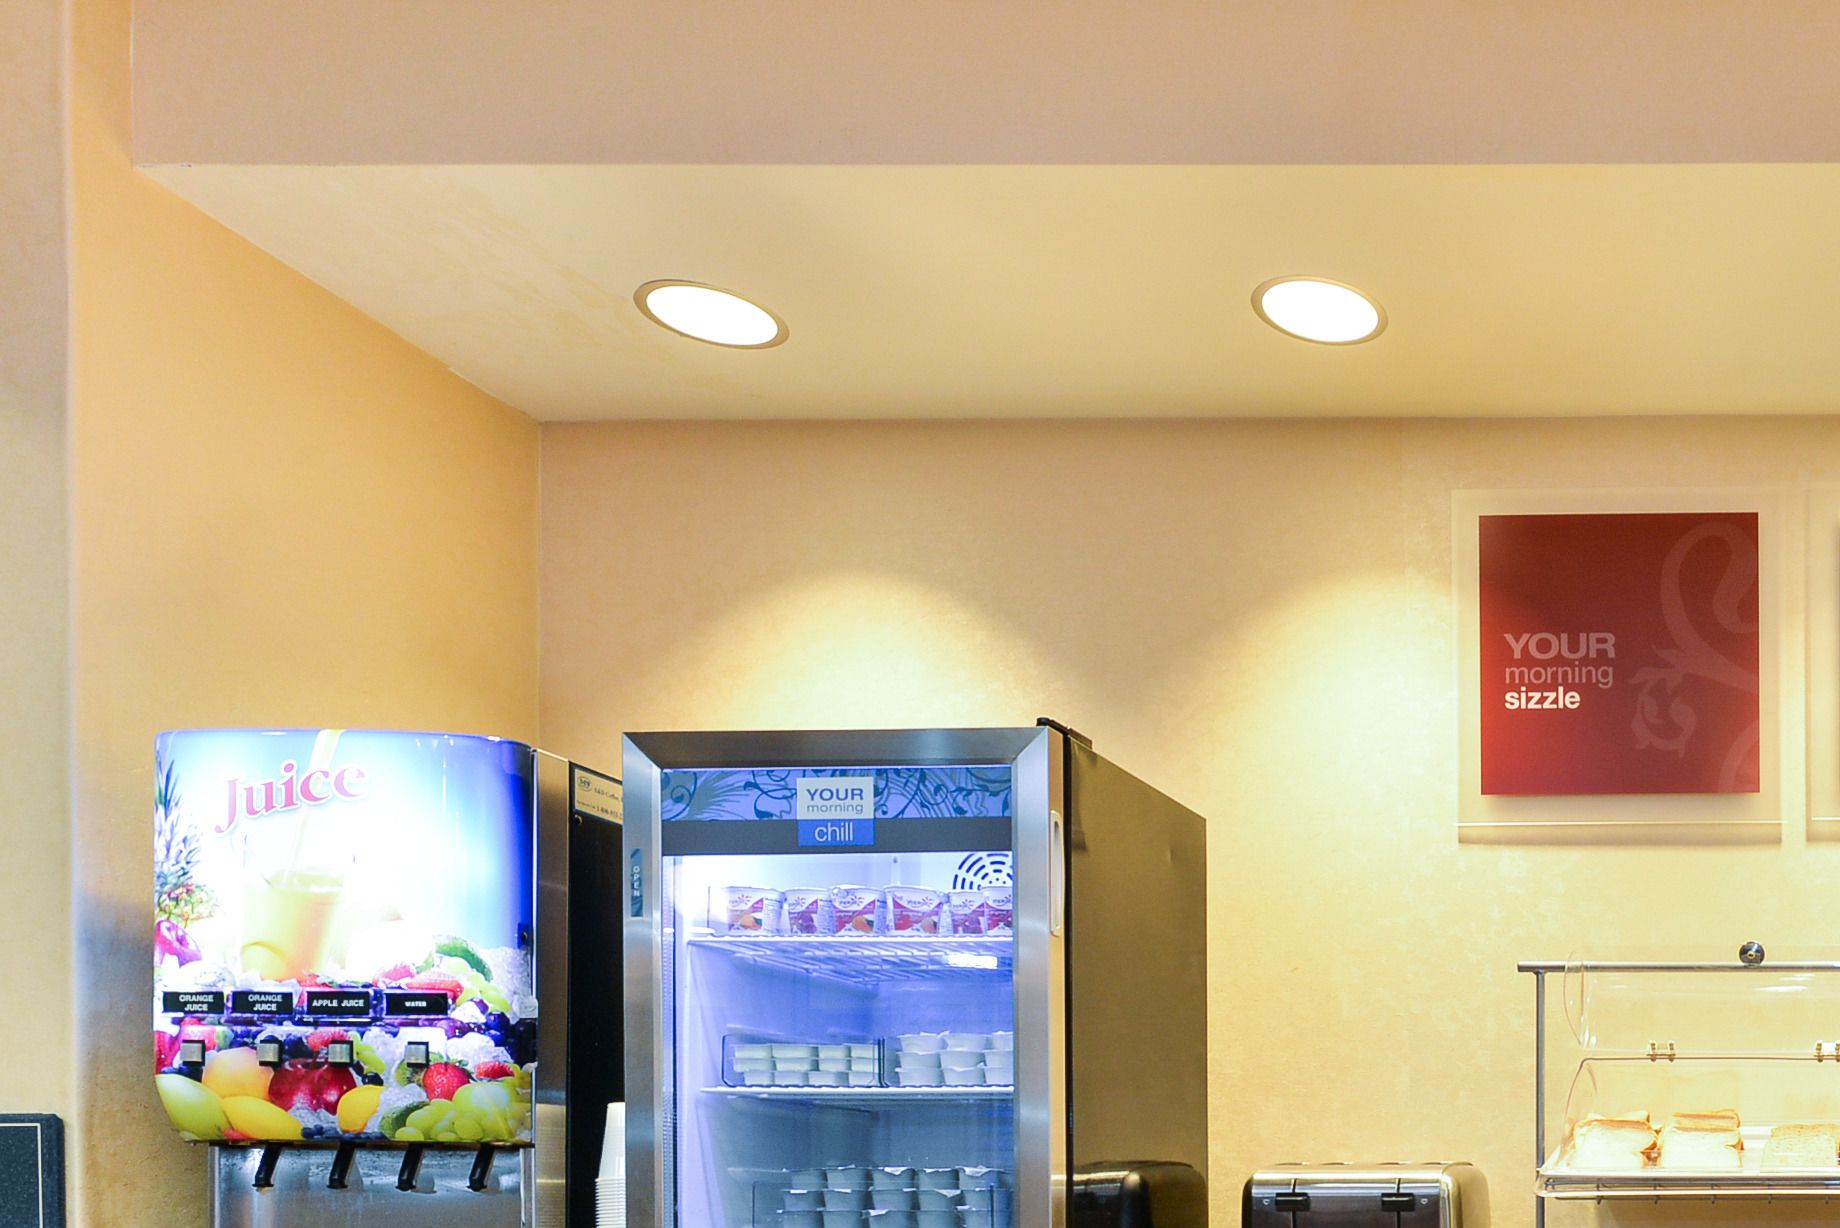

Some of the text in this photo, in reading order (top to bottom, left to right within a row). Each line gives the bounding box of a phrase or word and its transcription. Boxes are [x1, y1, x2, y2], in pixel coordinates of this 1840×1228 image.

[1503, 632, 1616, 659] YOUR
[1505, 661, 1613, 689] morning
[1504, 686, 1581, 710] sizzle
[214, 762, 367, 834] Juice
[806, 788, 864, 801] YOUR
[807, 802, 864, 815] morning
[814, 822, 854, 842] chill
[632, 866, 641, 897] OPEN
[179, 994, 214, 1003] ORANGE
[248, 994, 283, 1002] ORANGE
[312, 999, 365, 1008] APPLE JUICE
[404, 1000, 427, 1008] WATER
[184, 1003, 209, 1012] JUICE
[252, 1003, 277, 1012] JUICE
